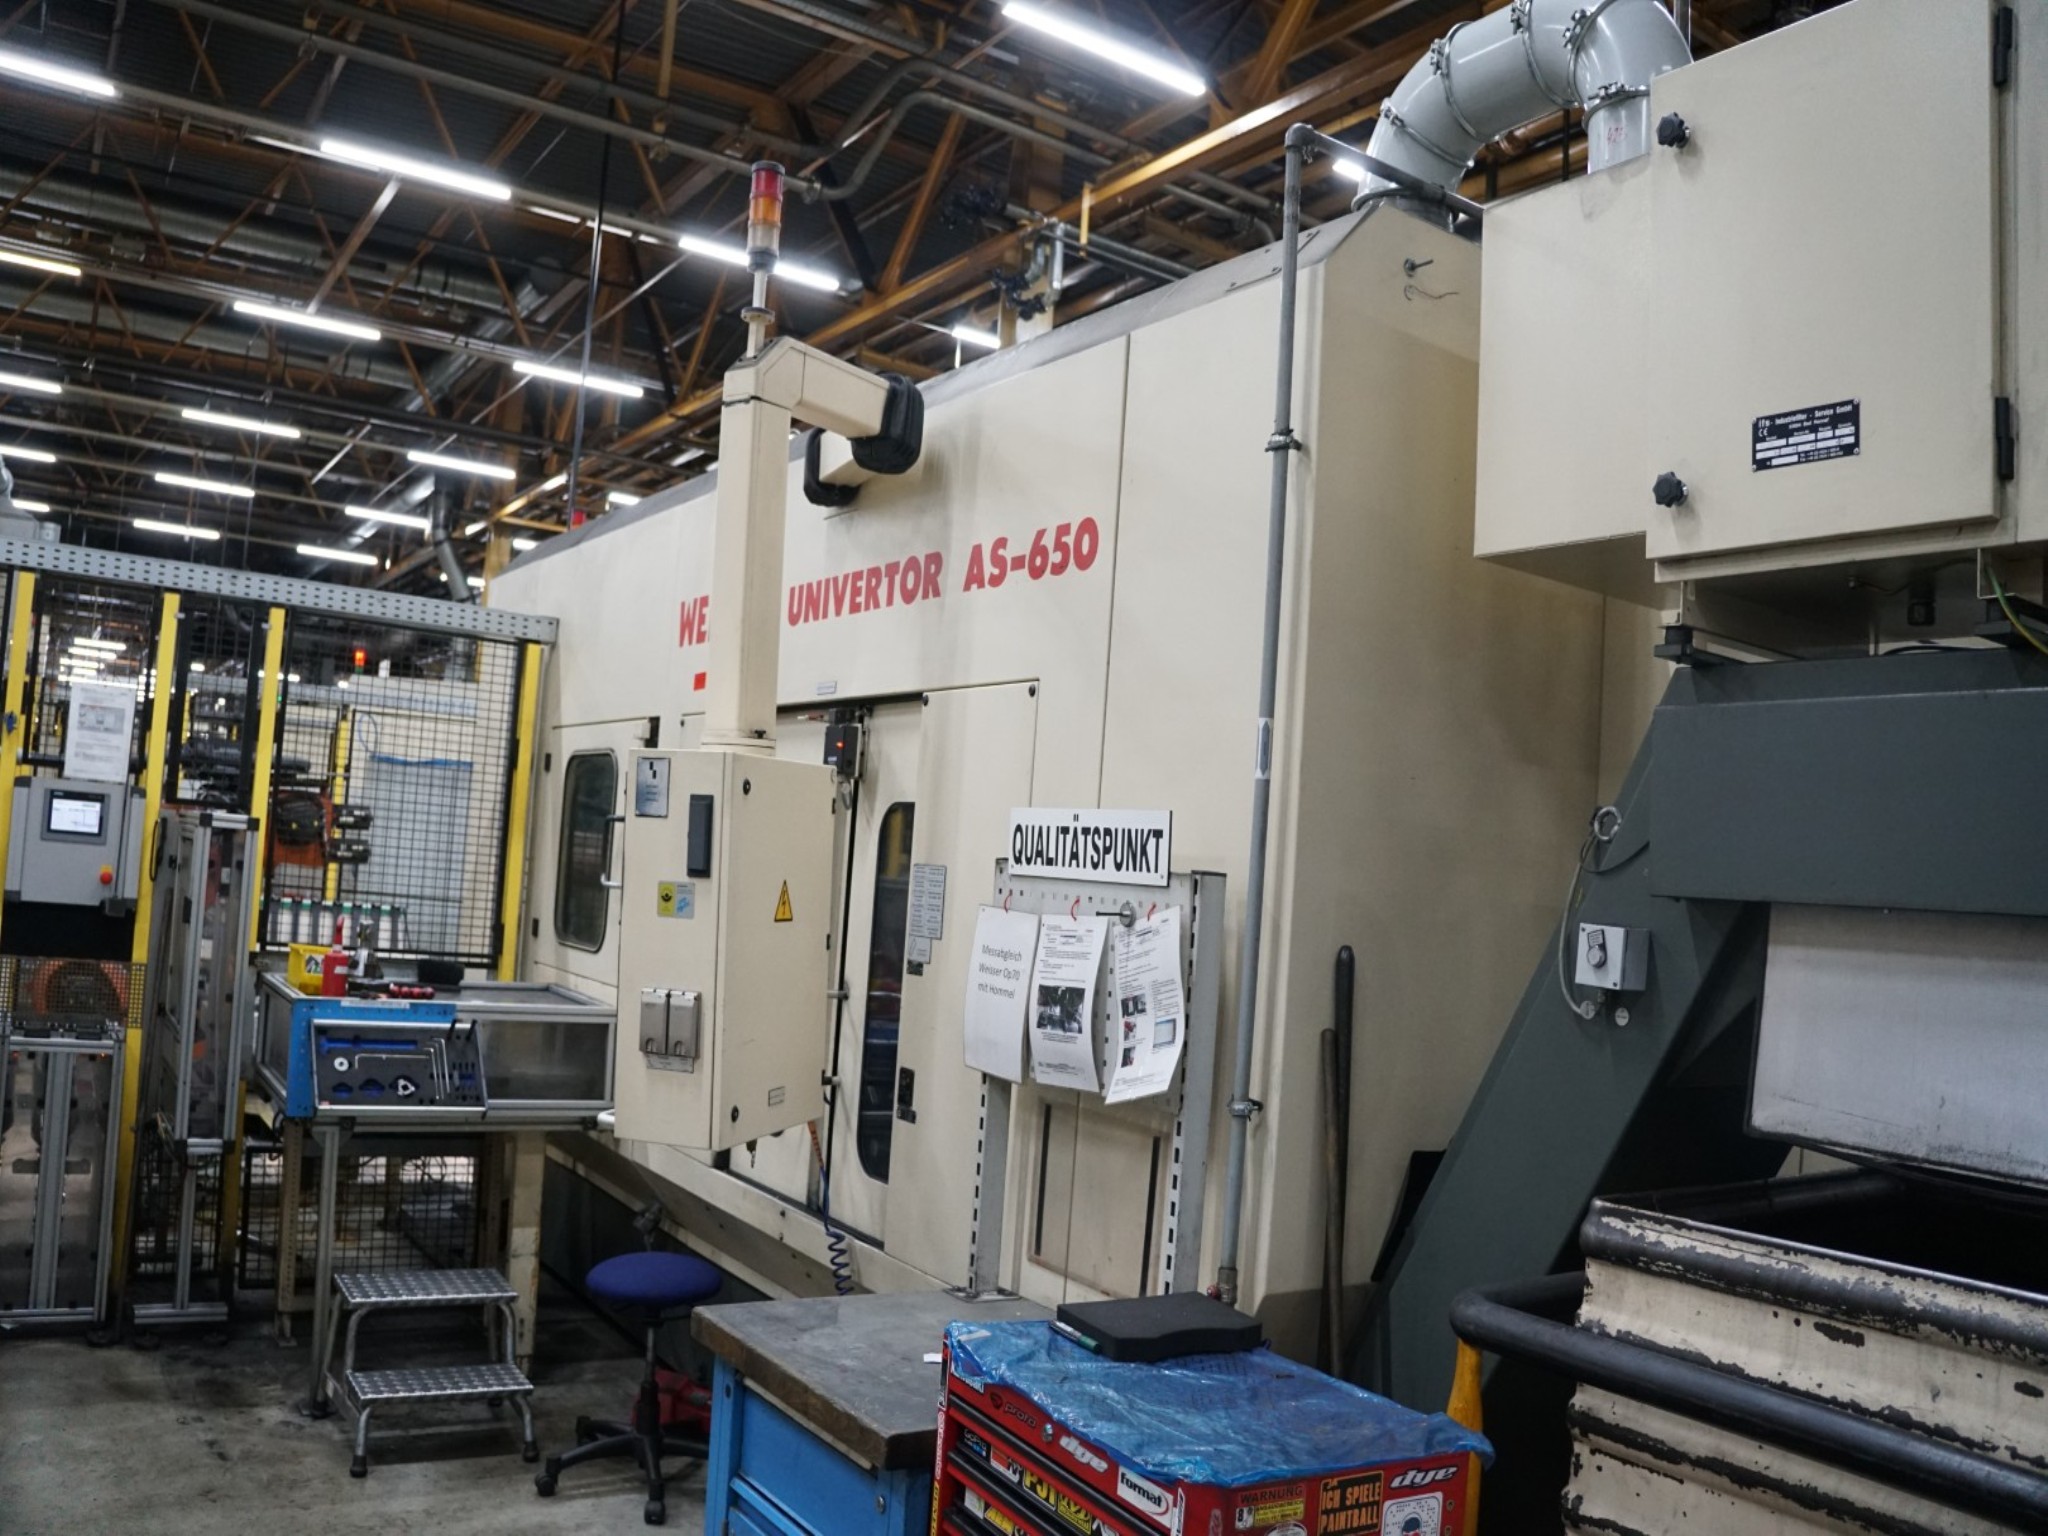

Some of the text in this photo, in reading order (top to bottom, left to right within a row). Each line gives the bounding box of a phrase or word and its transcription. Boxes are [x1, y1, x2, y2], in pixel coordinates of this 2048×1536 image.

[679, 517, 1099, 647] WE UNIVERTOR AS-650
[1013, 813, 1164, 874] QUALITÄTSPUNKT
[1059, 1435, 1108, 1473] dye
[1120, 1472, 1162, 1508] format
[1240, 1484, 1304, 1504] WARNUNG
[1390, 1466, 1458, 1489] dye
[1321, 1488, 1341, 1511] ICH
[1345, 1481, 1381, 1506] SPIELE
[1320, 1505, 1379, 1534] PAINTBALL
